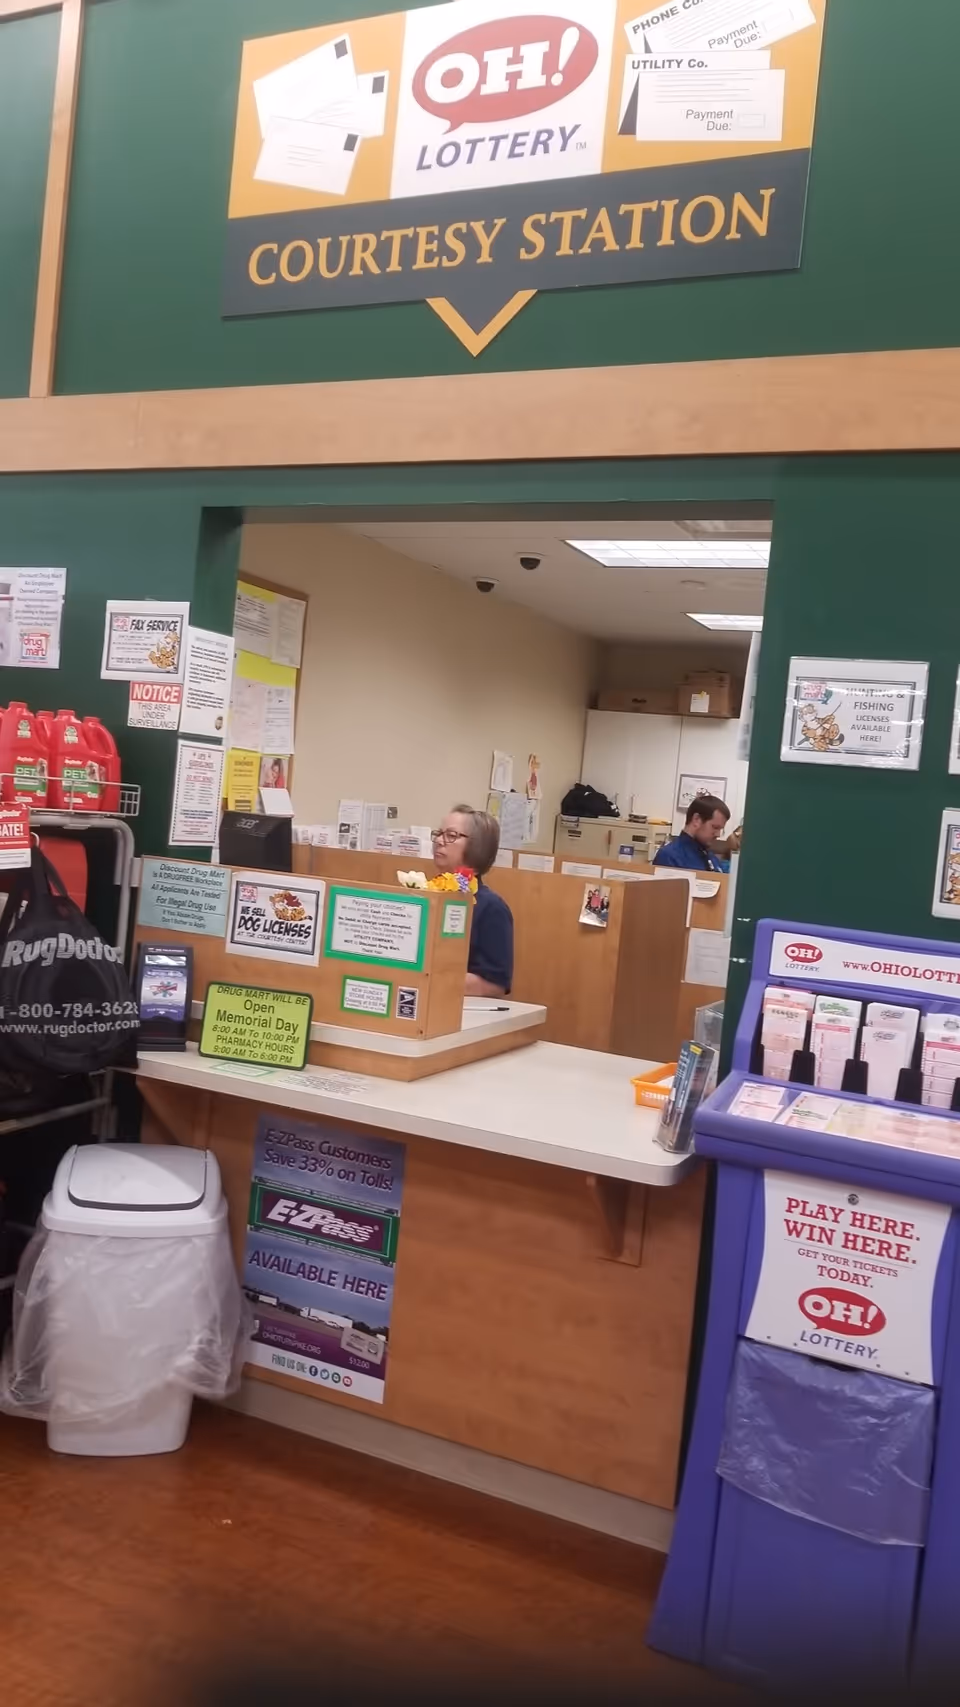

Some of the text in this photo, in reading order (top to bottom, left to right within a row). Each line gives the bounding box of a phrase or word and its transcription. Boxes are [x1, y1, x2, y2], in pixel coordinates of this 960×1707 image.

[632, 6, 680, 34] PHONE
[708, 20, 759, 49] Payment
[734, 31, 762, 49] Due:
[424, 26, 580, 105] OH!
[631, 58, 708, 70] UTILITY Co.
[685, 109, 734, 121] Payment
[706, 120, 732, 131] Due:
[416, 124, 582, 171] LOTTERY
[248, 188, 776, 286] COURTESY STATION
[129, 619, 147, 631] FAX
[146, 620, 179, 632] SERVICE
[132, 683, 180, 702] NOTICE
[138, 702, 171, 711] THIS AREA
[853, 701, 894, 712] FISHING
[128, 718, 176, 729] SURVEILLANCE
[142, 711, 165, 720] UNDER
[856, 714, 889, 723] LICENSES
[850, 724, 891, 733] AVAILABLE
[859, 735, 882, 743] HERE!
[160, 864, 225, 878] Discount Drug Mart
[163, 872, 194, 882] DRUGFREE
[195, 876, 223, 886] Workplace
[160, 885, 189, 894] Applicants
[201, 890, 221, 899] Tested
[156, 896, 217, 911] For Illegal Drug Use
[241, 906, 266, 917] WE SELL
[238, 915, 312, 939] DOG LICENSES
[786, 946, 820, 960] OH!
[785, 963, 820, 972] LOTTERY
[217, 986, 308, 1006] DRUG MART WILL BE
[243, 999, 275, 1014] Open
[216, 1009, 299, 1035] Memorial Day
[232, 1027, 247, 1036] AM
[249, 1029, 259, 1038] To
[262, 1031, 284, 1042] 10:00
[286, 1035, 300, 1044] PM
[216, 1035, 295, 1055] PHARMACY HOURS
[213, 1045, 293, 1063] 9:00 AM To 6:00 PM
[264, 1128, 392, 1170] E-ZPass Customers
[264, 1148, 394, 1191] Save 33% on Tolls!
[785, 1197, 920, 1242] PLAY HERE.
[783, 1218, 917, 1265] WIN HERE.
[798, 1247, 898, 1278] GET YOUR TICKETS
[249, 1250, 388, 1301] AVAILABLE HERE
[817, 1265, 874, 1289] TODAY.
[803, 1293, 879, 1330] OH!
[800, 1330, 879, 1360] LOTTERY
[272, 1353, 286, 1367] FIND
[286, 1357, 296, 1370] US
